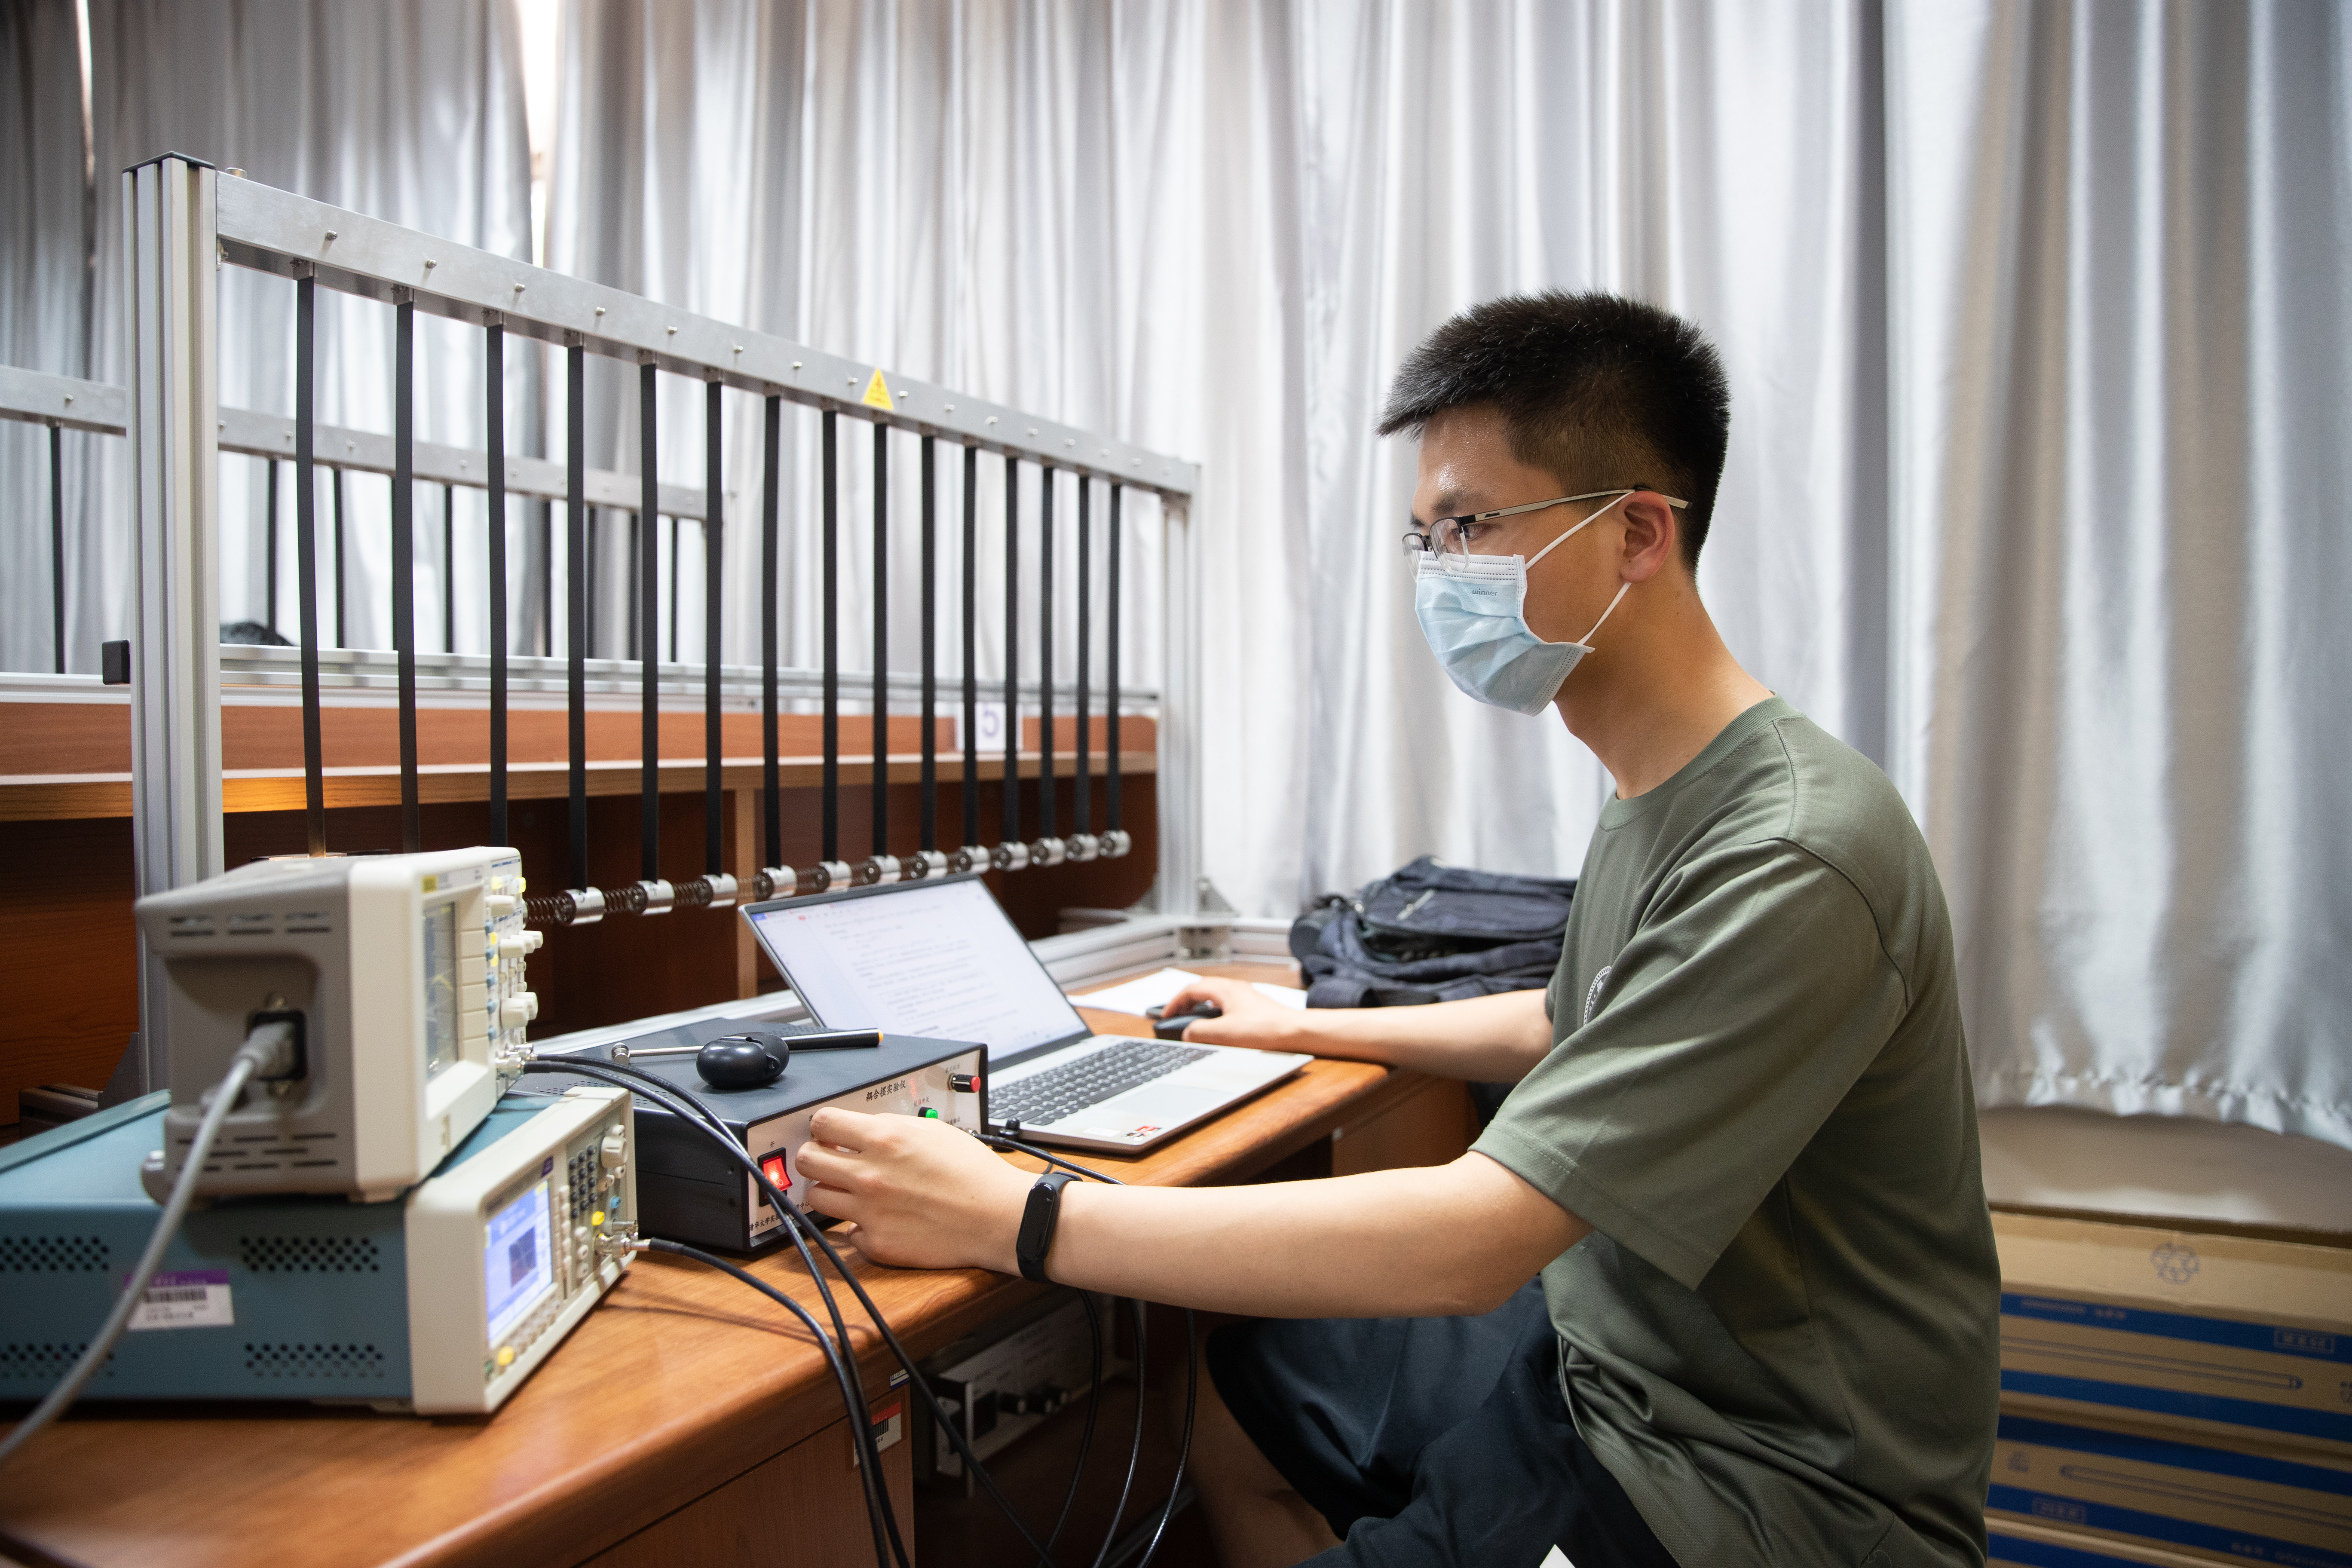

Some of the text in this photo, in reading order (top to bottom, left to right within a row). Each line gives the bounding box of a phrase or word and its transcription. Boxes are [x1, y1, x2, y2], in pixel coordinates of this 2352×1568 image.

[1472, 588, 1498, 596] winner
[866, 1080, 906, 1102] 耦合摆实验仪
